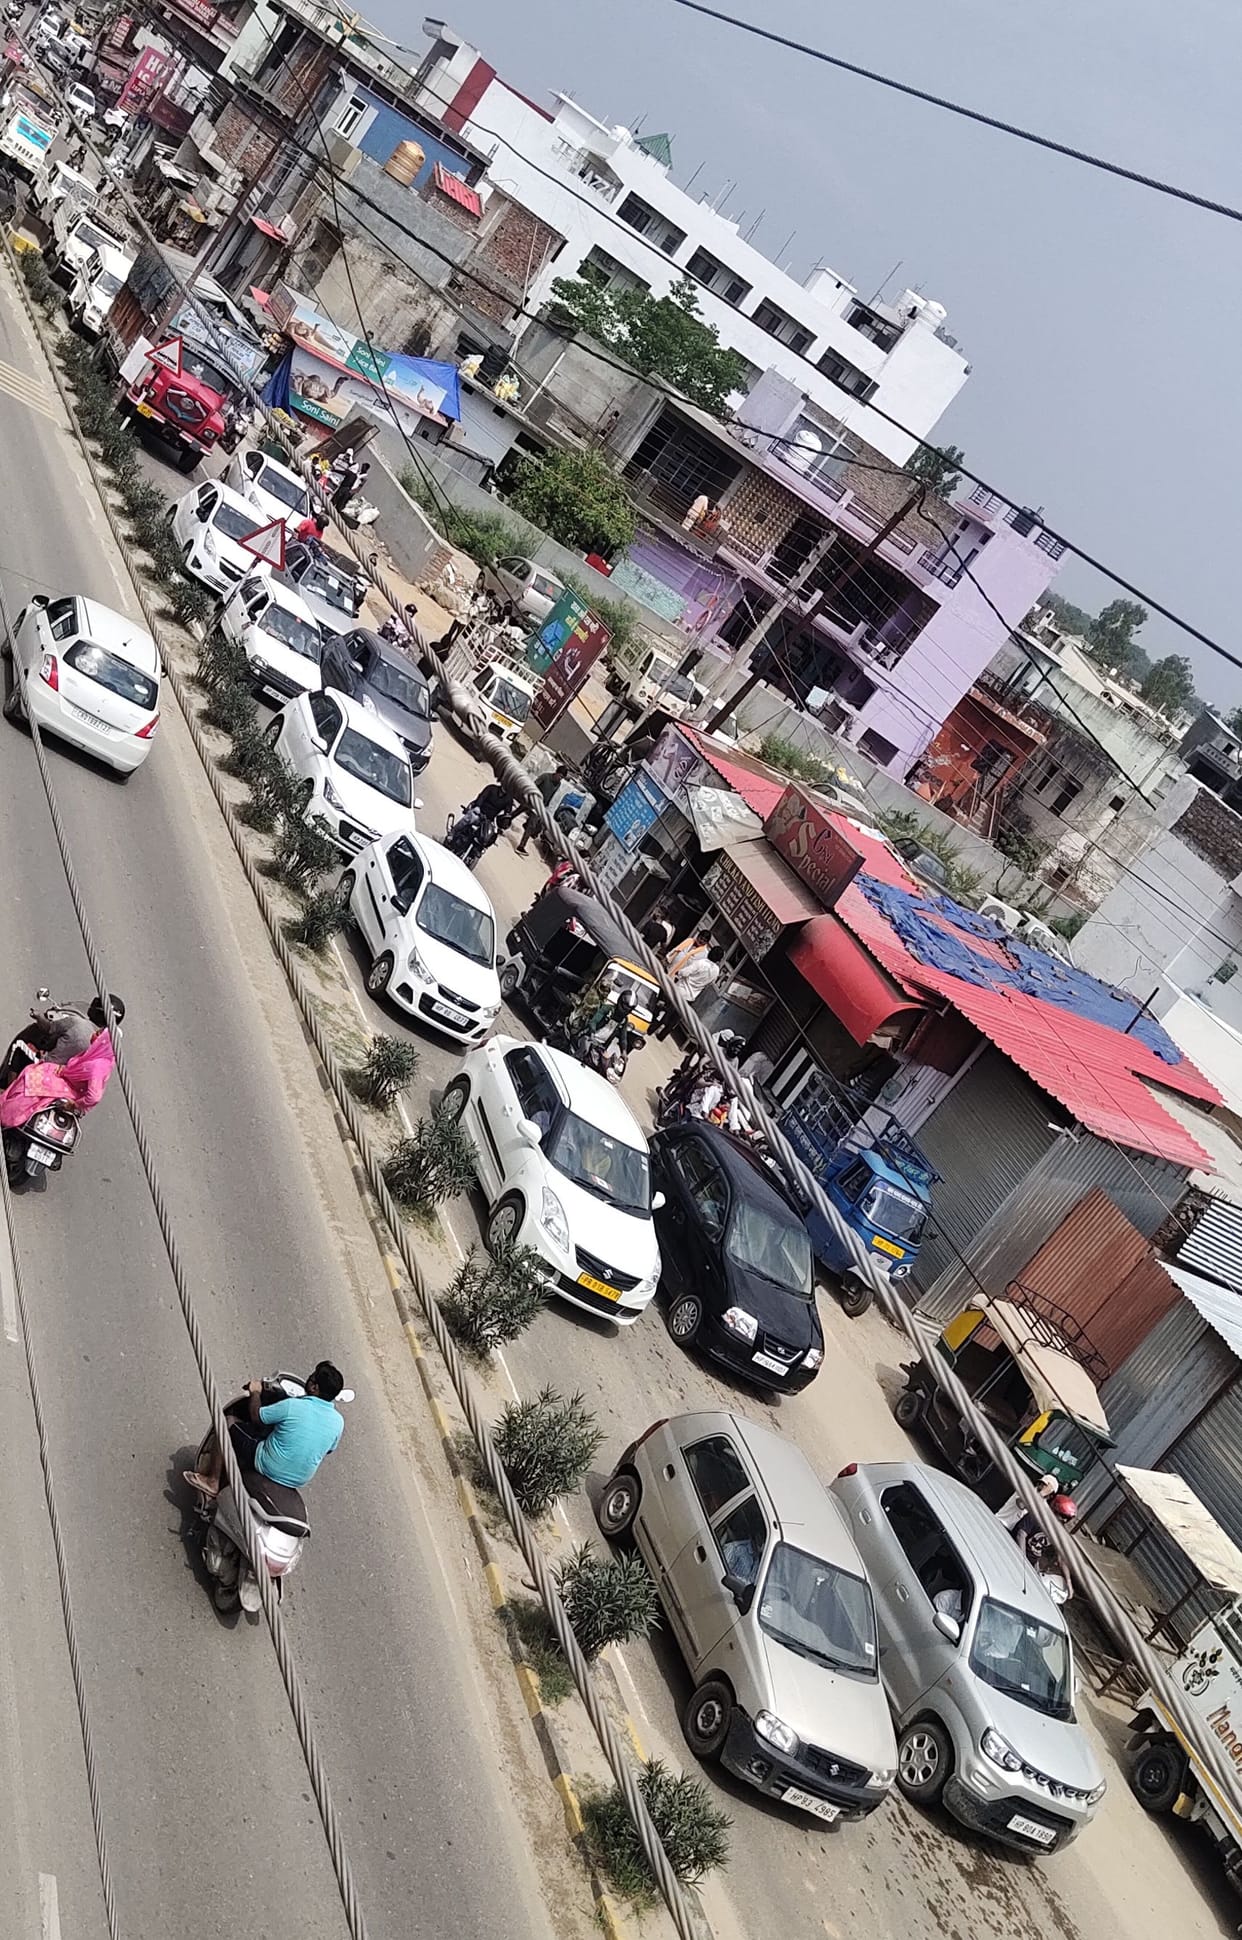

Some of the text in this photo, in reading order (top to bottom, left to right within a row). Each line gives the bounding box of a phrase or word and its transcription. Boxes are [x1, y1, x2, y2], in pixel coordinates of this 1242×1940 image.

[357, 346, 371, 359] Soni
[302, 400, 341, 427] Soni Saini
[789, 822, 836, 894] Special
[814, 1802, 835, 1819] 4985
